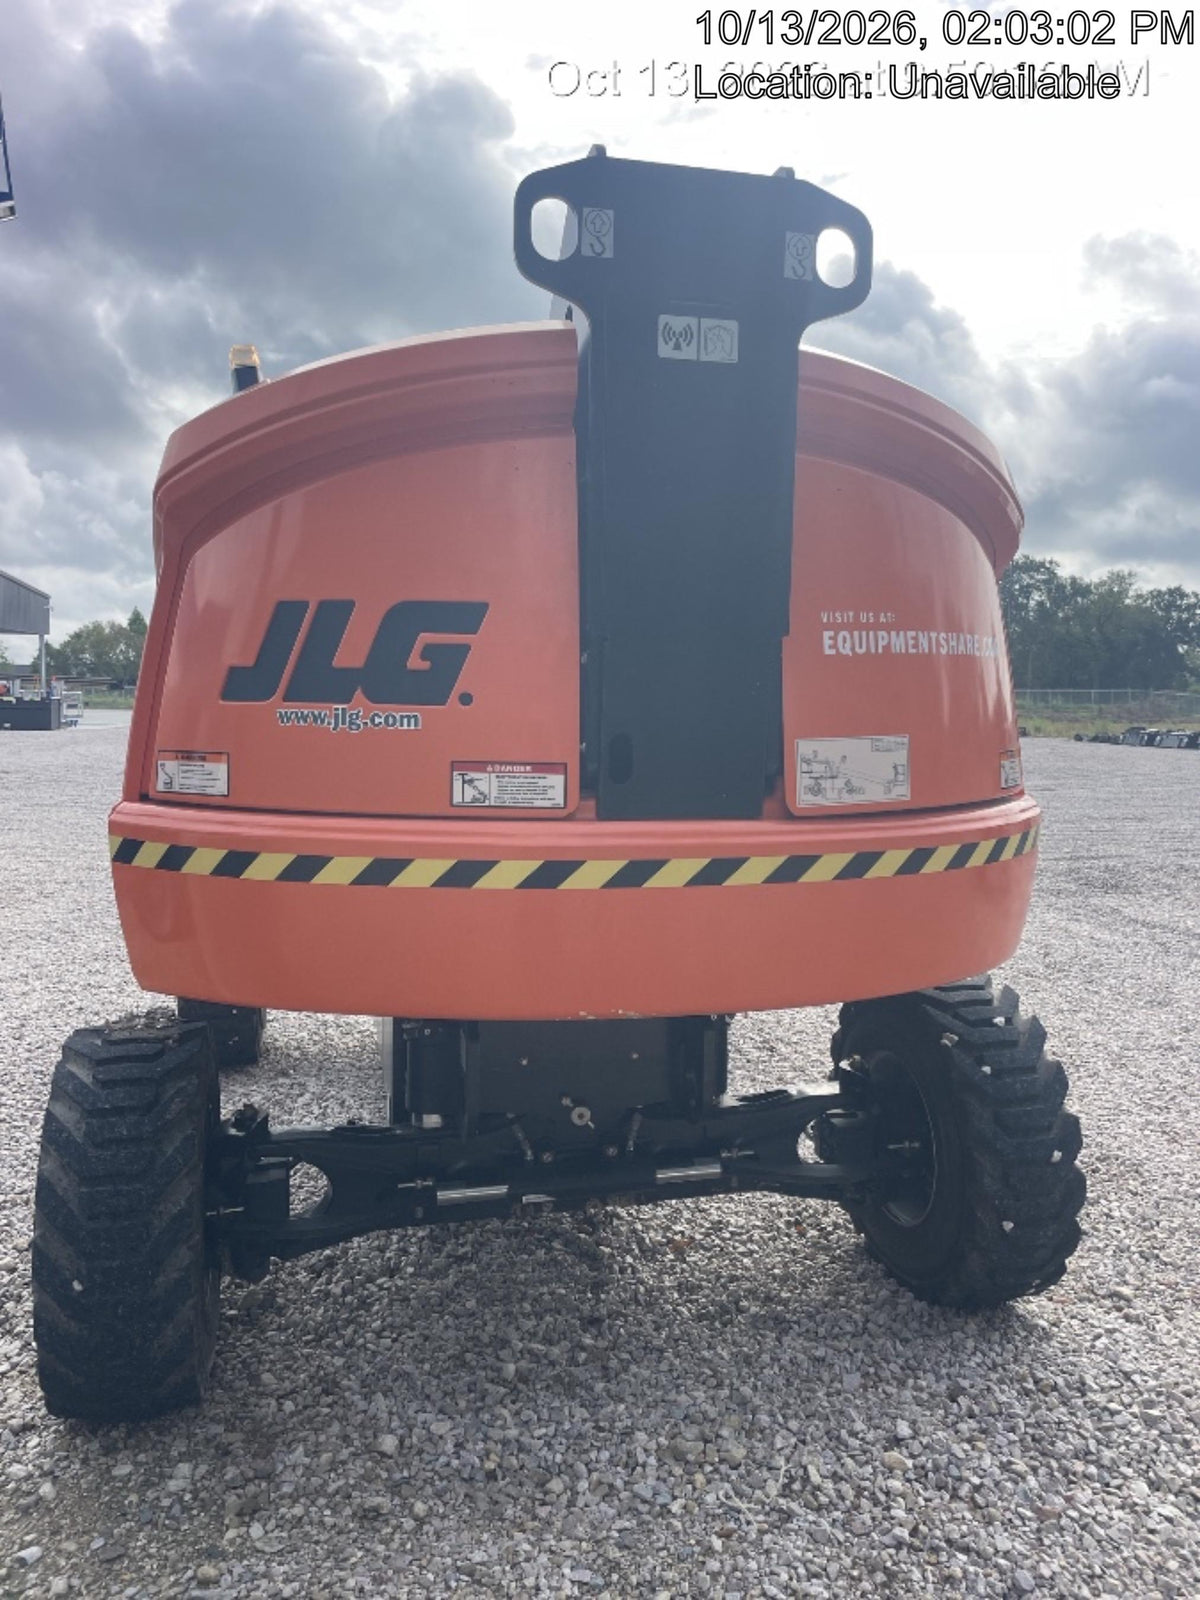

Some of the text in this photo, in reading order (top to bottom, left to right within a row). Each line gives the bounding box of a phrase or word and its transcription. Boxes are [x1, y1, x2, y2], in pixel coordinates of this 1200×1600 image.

[820, 611, 854, 623] VISIT
[860, 612, 874, 623] US
[277, 705, 422, 733] www.jlg.com
